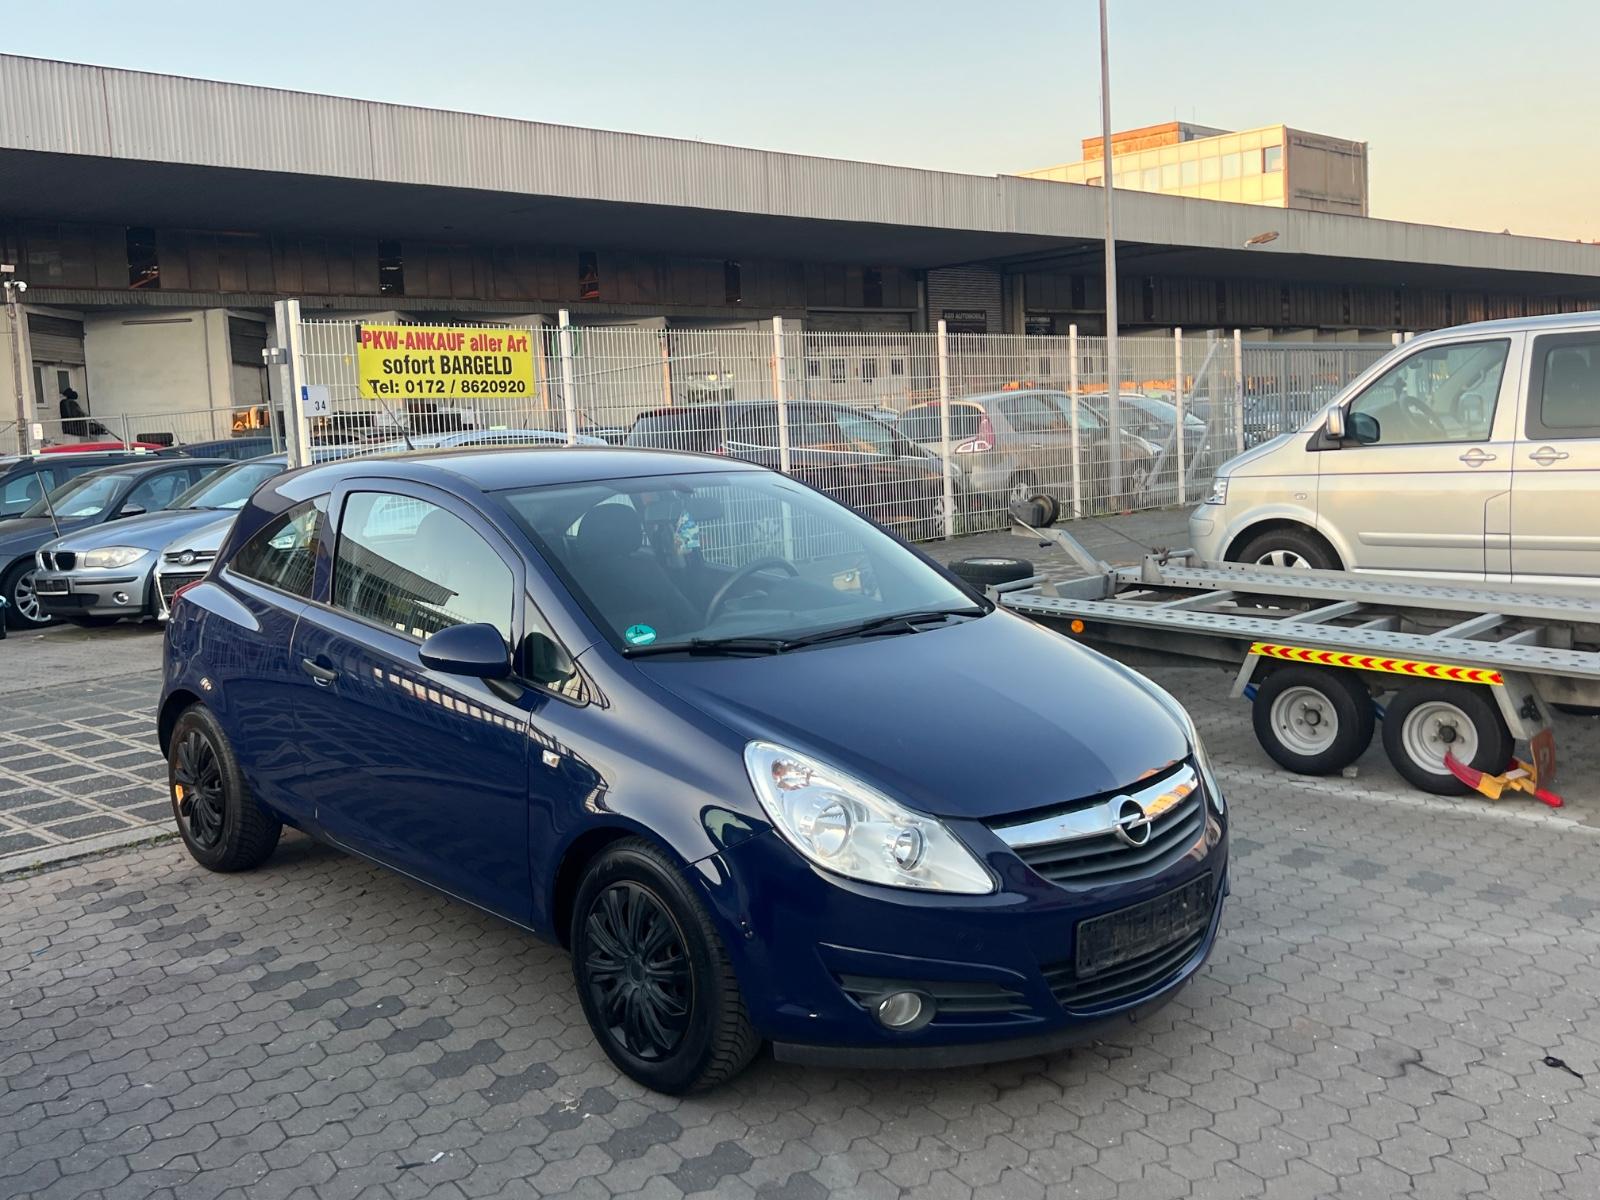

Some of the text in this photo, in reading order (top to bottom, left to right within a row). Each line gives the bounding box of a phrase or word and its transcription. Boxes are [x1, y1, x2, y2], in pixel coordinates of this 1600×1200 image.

[361, 330, 528, 352] PKW-ANKAUF aller Art
[383, 355, 512, 375] sofort BARGELD
[370, 379, 526, 394] Tel: 0172 / 8620920
[314, 400, 326, 411] 34
